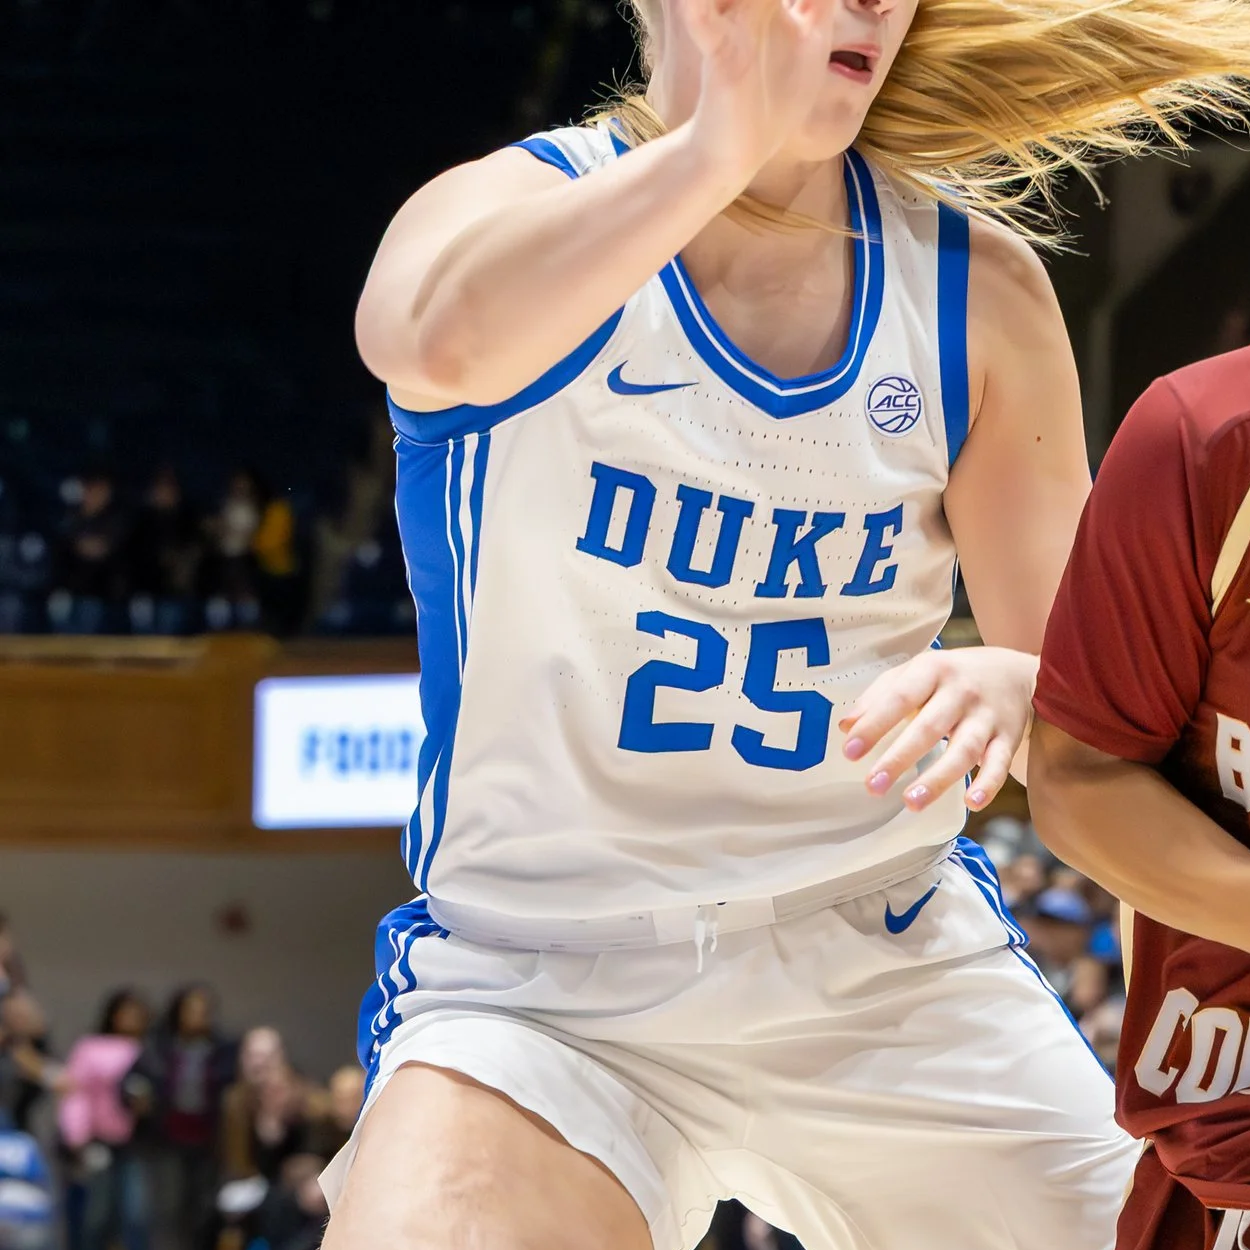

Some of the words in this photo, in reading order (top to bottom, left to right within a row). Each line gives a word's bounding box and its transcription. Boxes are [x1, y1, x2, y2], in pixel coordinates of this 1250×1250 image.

[874, 394, 919, 409] ACC
[576, 461, 903, 599] DUKE
[617, 610, 833, 771] 25
